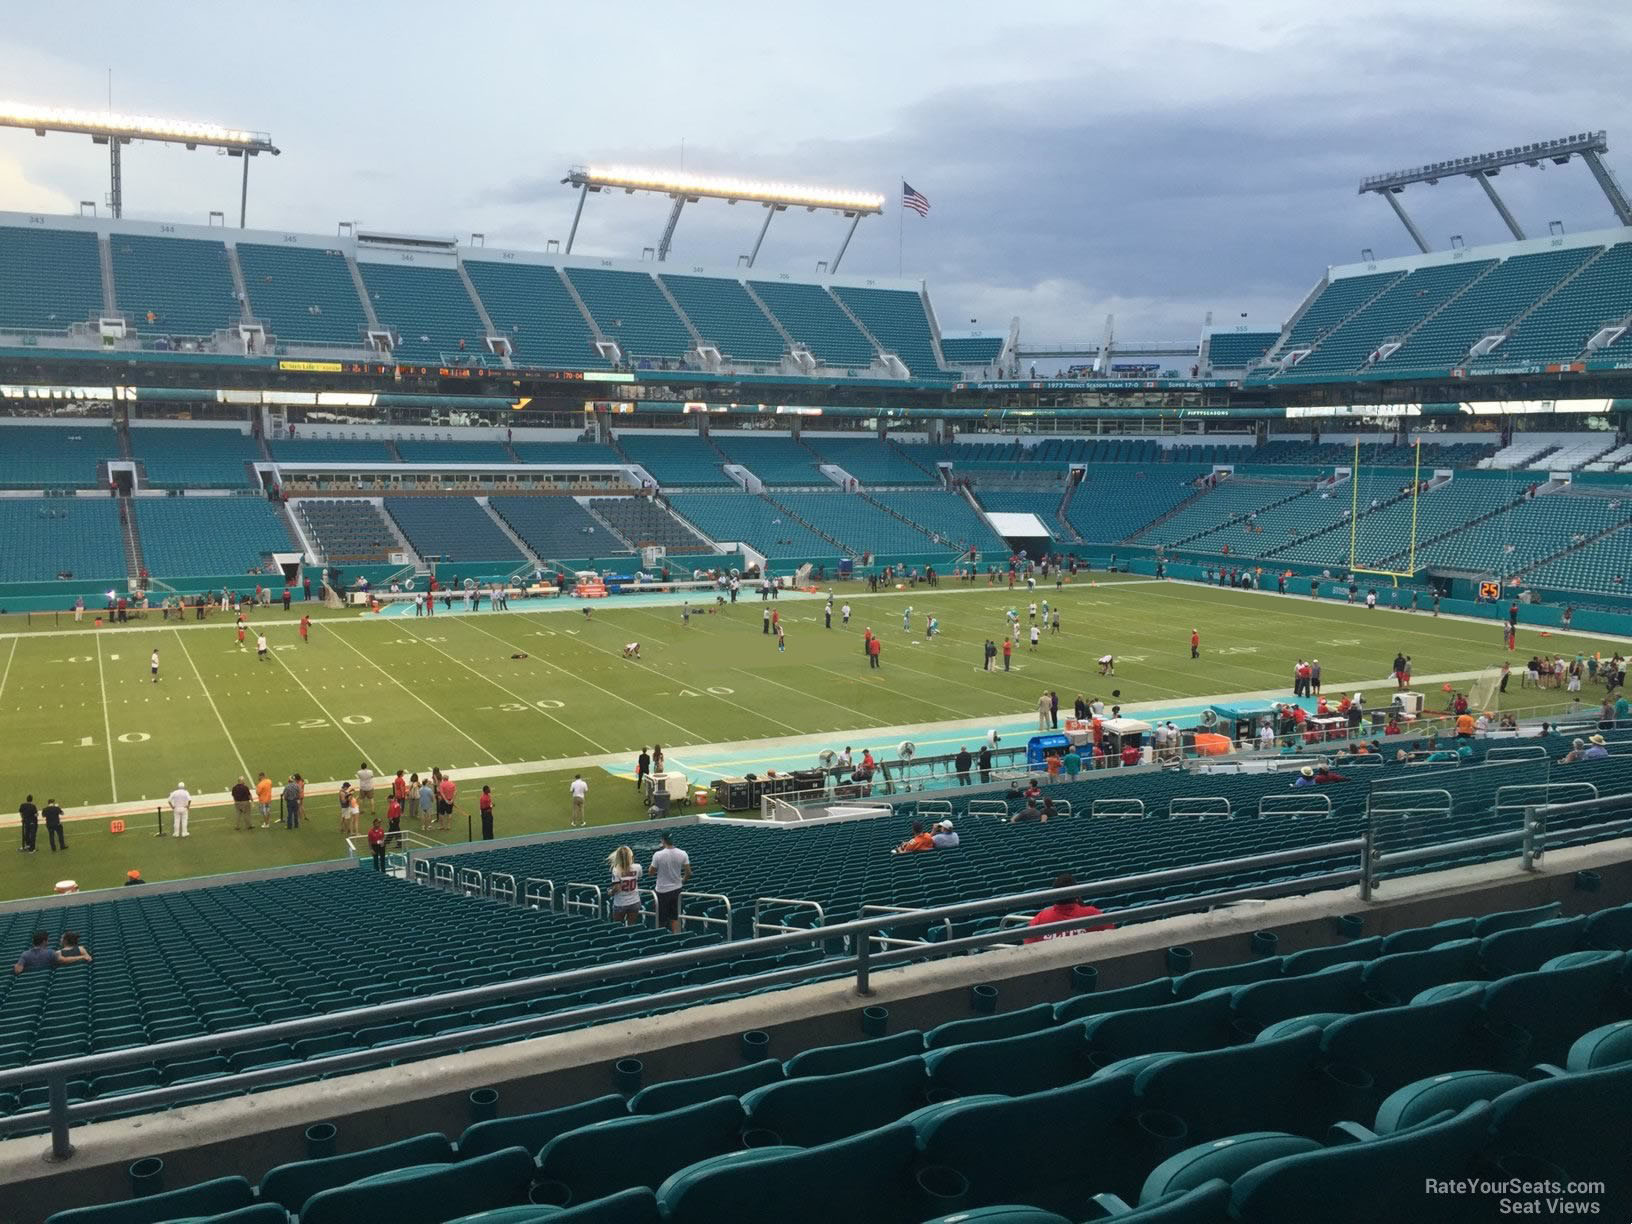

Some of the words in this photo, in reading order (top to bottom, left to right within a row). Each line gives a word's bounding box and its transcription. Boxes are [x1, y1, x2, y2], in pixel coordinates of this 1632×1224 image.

[160, 225, 175, 233] 344
[283, 232, 297, 243] 345
[1481, 583, 1498, 597] 25
[74, 731, 151, 747] 10
[621, 879, 636, 892] 20
